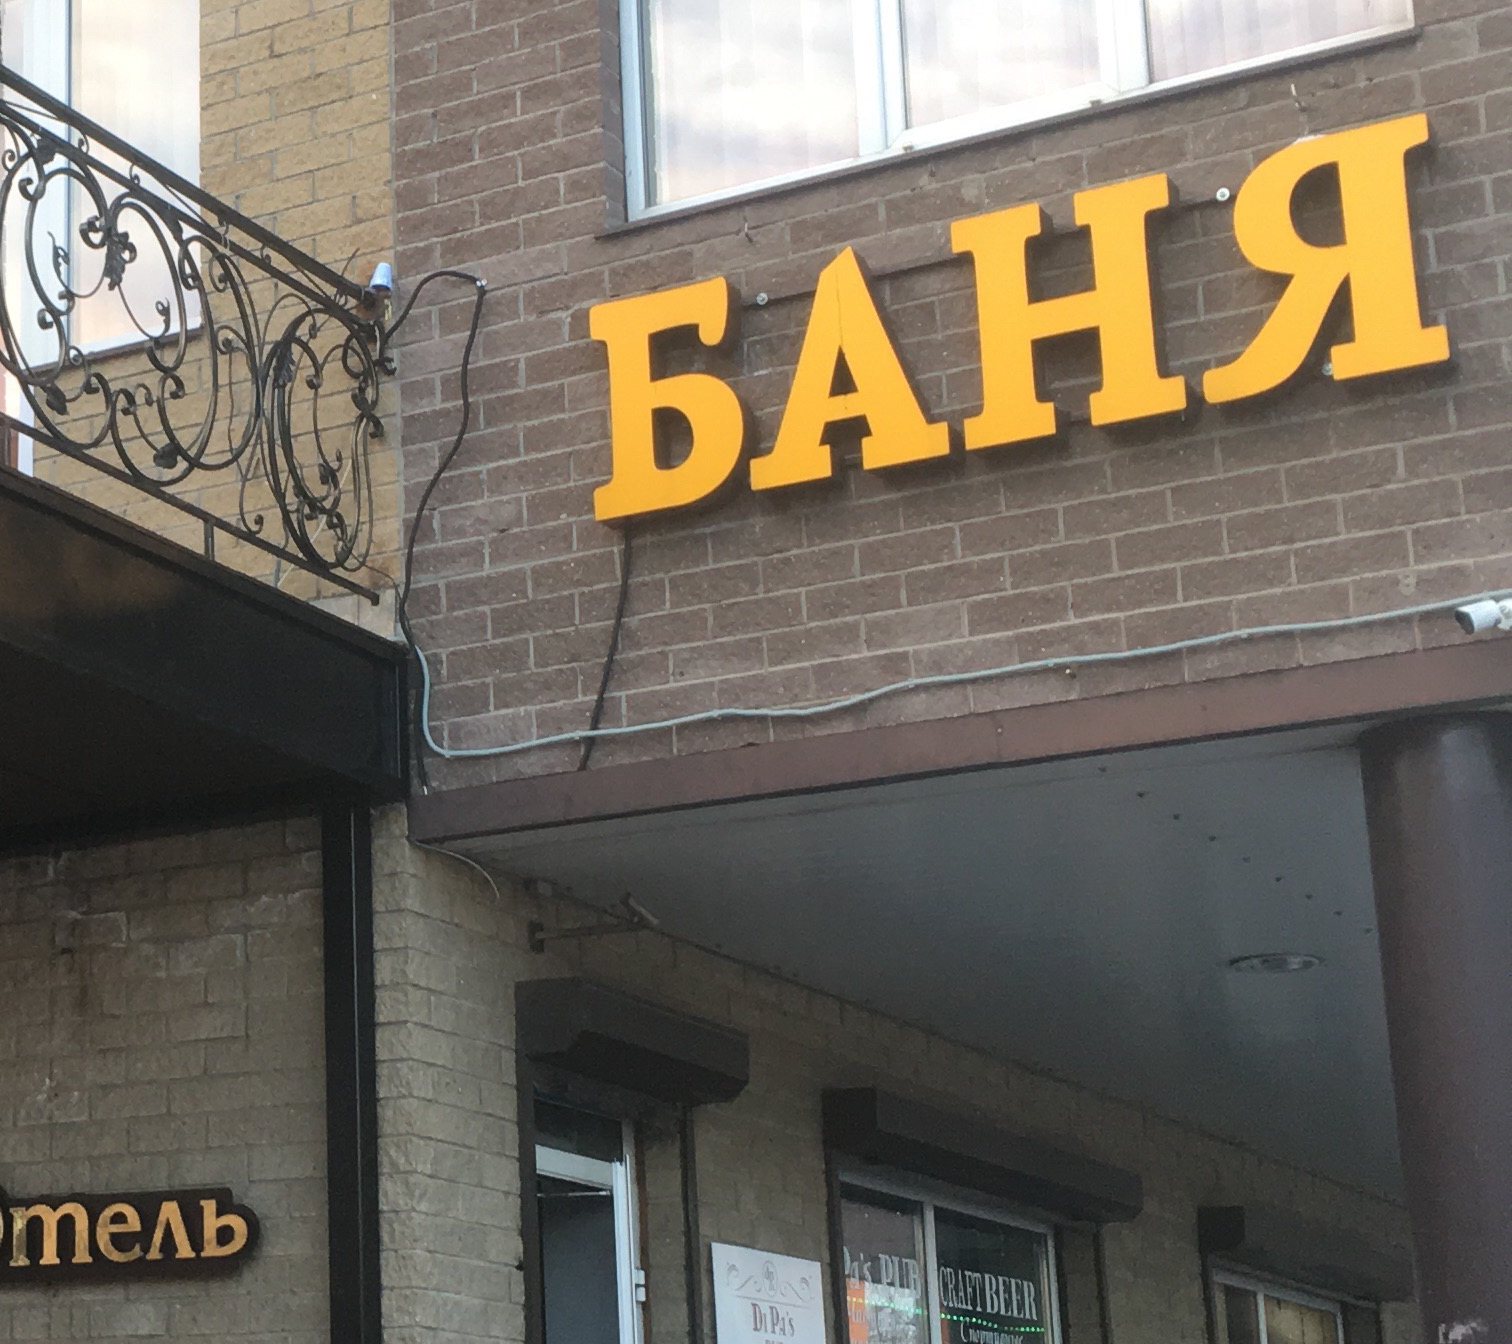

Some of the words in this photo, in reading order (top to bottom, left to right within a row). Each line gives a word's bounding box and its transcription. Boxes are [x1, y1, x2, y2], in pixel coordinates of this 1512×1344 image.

[589, 113, 1450, 522] БАНЯ
[940, 1266, 982, 1312] CRAFT
[984, 1273, 1037, 1320] BEER
